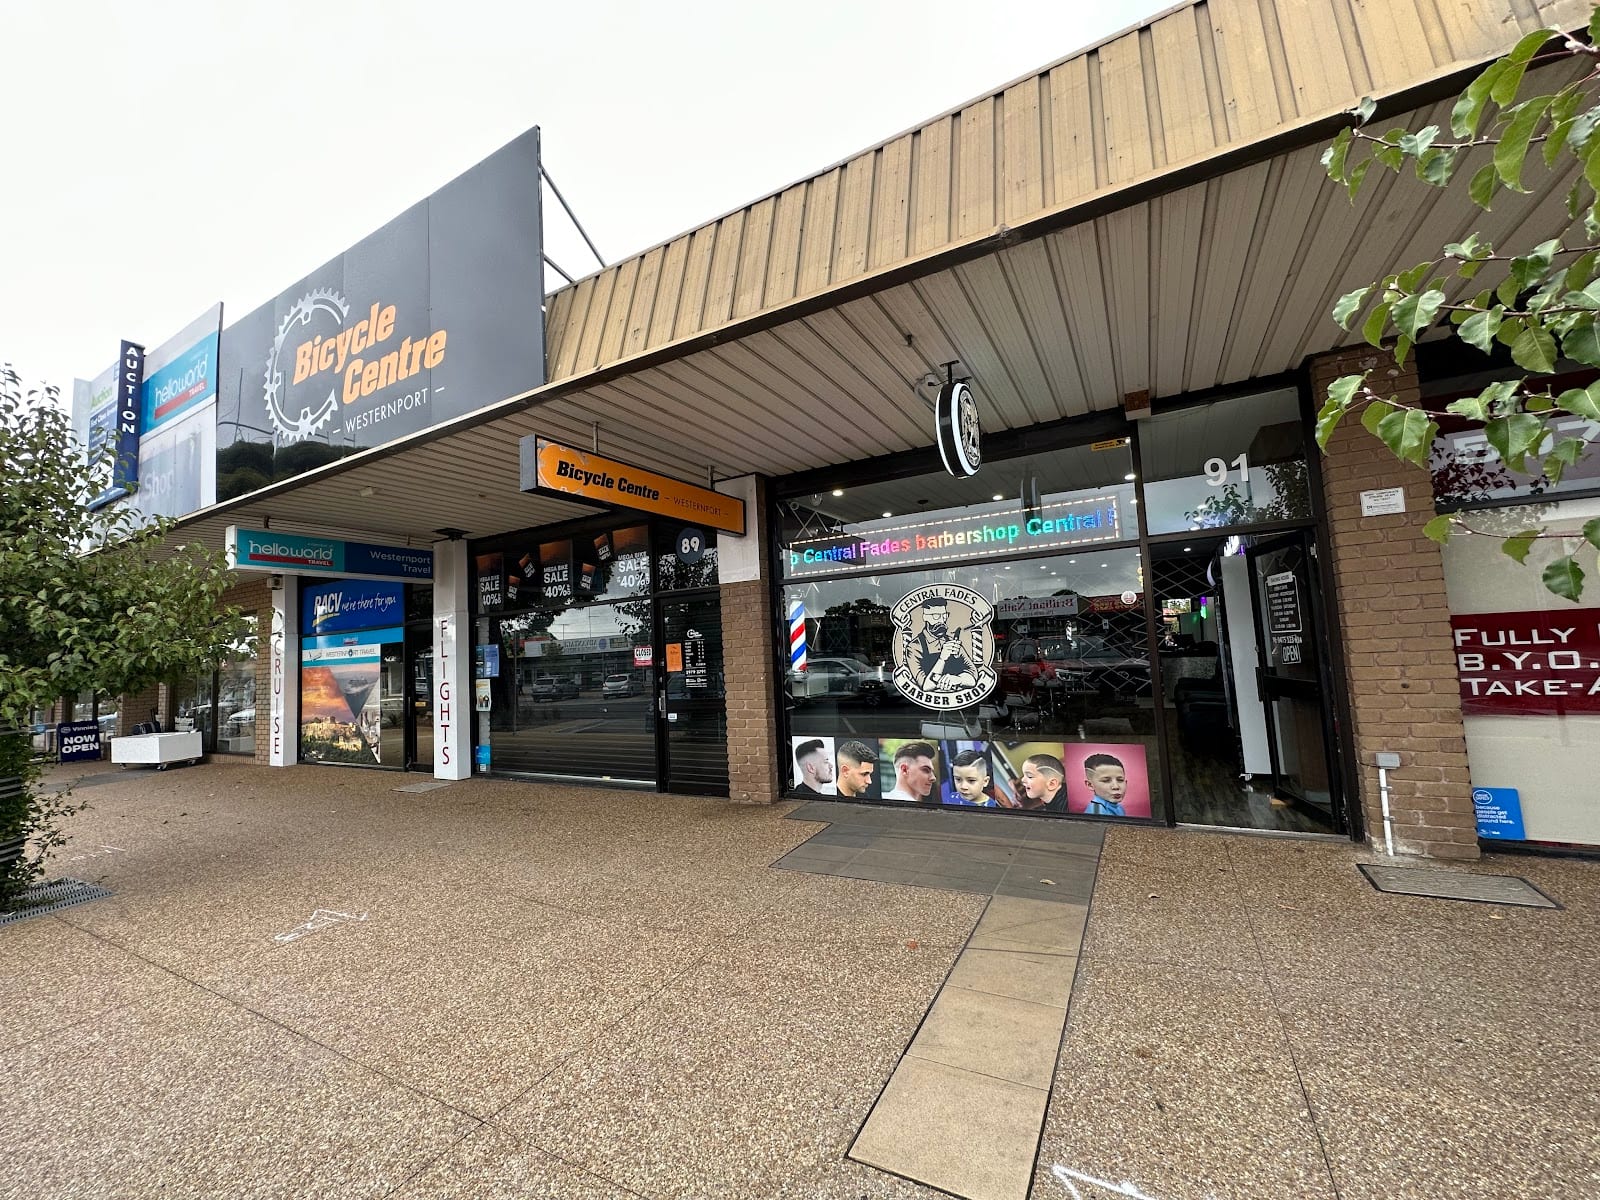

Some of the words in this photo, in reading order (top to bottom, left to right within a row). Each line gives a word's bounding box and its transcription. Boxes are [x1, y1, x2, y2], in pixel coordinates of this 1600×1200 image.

[292, 302, 397, 385] Bicycle
[342, 329, 447, 405] Centre
[121, 347, 138, 434] AUCTION
[155, 354, 208, 408] helloworld
[188, 382, 206, 397] TRAVEL
[345, 388, 428, 433] WESTERNPORT
[1203, 453, 1249, 486] 91
[556, 460, 614, 489] Bicycle
[617, 477, 660, 500] Centre
[673, 496, 721, 516] WESTERNPORT
[681, 536, 700, 554] 89
[803, 543, 857, 564] Central
[860, 538, 910, 558] Fades
[916, 524, 1020, 550] barbershop
[1026, 510, 1102, 536] Central
[249, 540, 334, 560] helloworld
[370, 550, 431, 564] Westernport
[401, 564, 431, 574] Travel
[543, 570, 569, 584] SALE
[618, 558, 648, 573] SALE
[480, 580, 500, 593] SALE
[314, 592, 343, 616] RACV
[357, 594, 374, 610] there
[374, 592, 385, 610] for
[381, 596, 396, 613] you
[899, 588, 942, 613] CENTRAL
[944, 588, 978, 605] FADES
[1454, 627, 1576, 647] FULLY
[635, 647, 652, 657] CLOSED
[1458, 650, 1600, 672] B.Y.O.
[273, 639, 282, 754] CRUISE
[439, 619, 451, 766] FLIGHTS
[901, 681, 950, 706] BARBER
[955, 683, 987, 704] SHOP
[61, 742, 99, 754] OPEN
[63, 734, 96, 745] NOW
